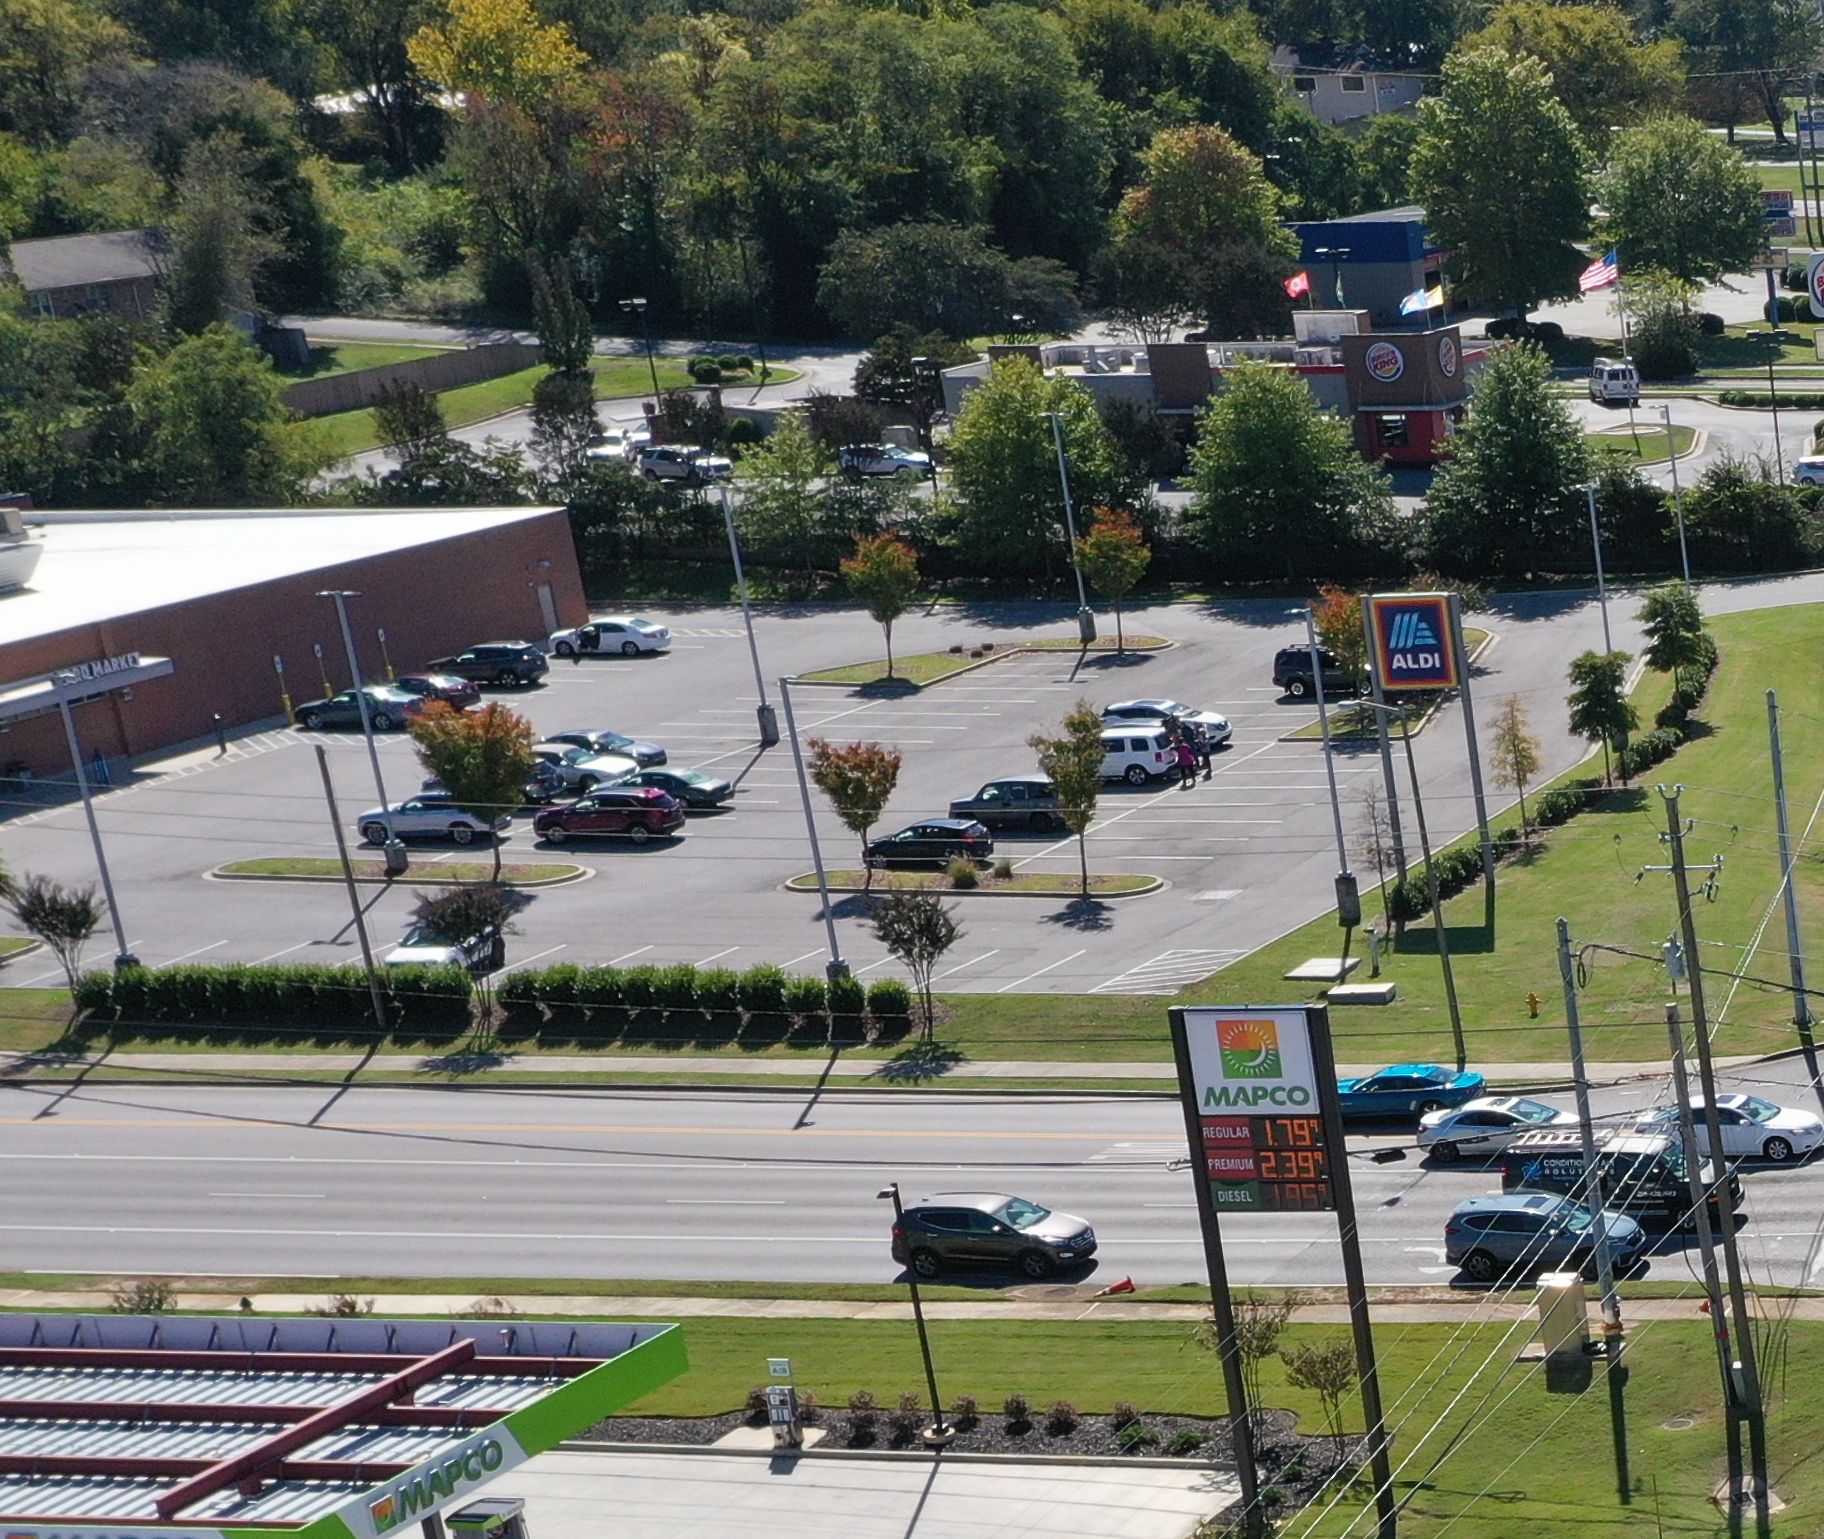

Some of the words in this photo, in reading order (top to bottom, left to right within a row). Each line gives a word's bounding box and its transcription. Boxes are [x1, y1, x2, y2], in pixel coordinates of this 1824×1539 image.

[92, 651, 140, 677] MARKET
[1392, 652, 1441, 669] ALDI
[1203, 1085, 1310, 1107] MAPCO
[1203, 1126, 1250, 1139] REGULAR
[1208, 1158, 1254, 1170] PREMIUM
[1543, 1159, 1599, 1167] CONDITIO
[1218, 1190, 1253, 1202] DIESEL
[397, 1437, 504, 1525] MAPCO
